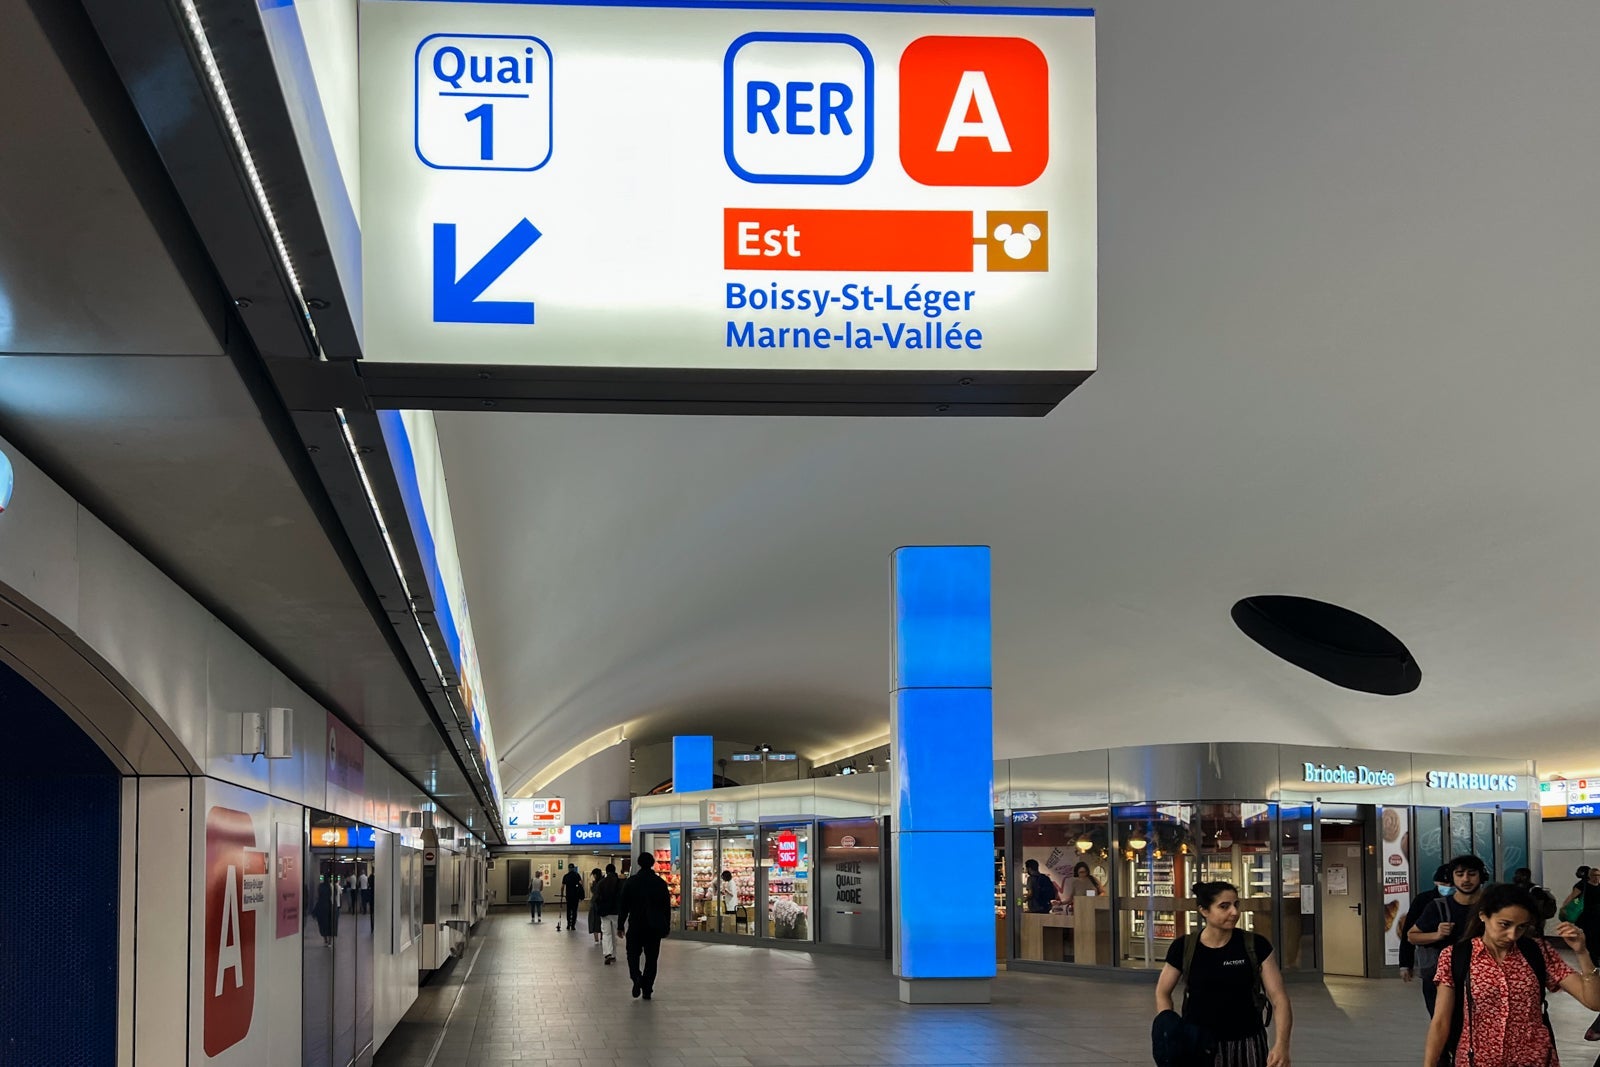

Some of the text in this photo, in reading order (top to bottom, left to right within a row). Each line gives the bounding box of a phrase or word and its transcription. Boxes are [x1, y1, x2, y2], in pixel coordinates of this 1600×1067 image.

[433, 46, 534, 87] Quai
[747, 81, 853, 135] RER
[936, 71, 1012, 153] A
[465, 104, 494, 160] 1
[738, 222, 801, 256] Est
[726, 282, 976, 313] Boissy-St-Léger
[726, 321, 983, 349] Marne-la-Vallée
[1304, 762, 1395, 787] Brioche Dorée
[1429, 771, 1518, 792] STARBUCKS
[1569, 805, 1594, 815] Sortie
[575, 830, 602, 840] Opéra
[214, 864, 244, 998] A
